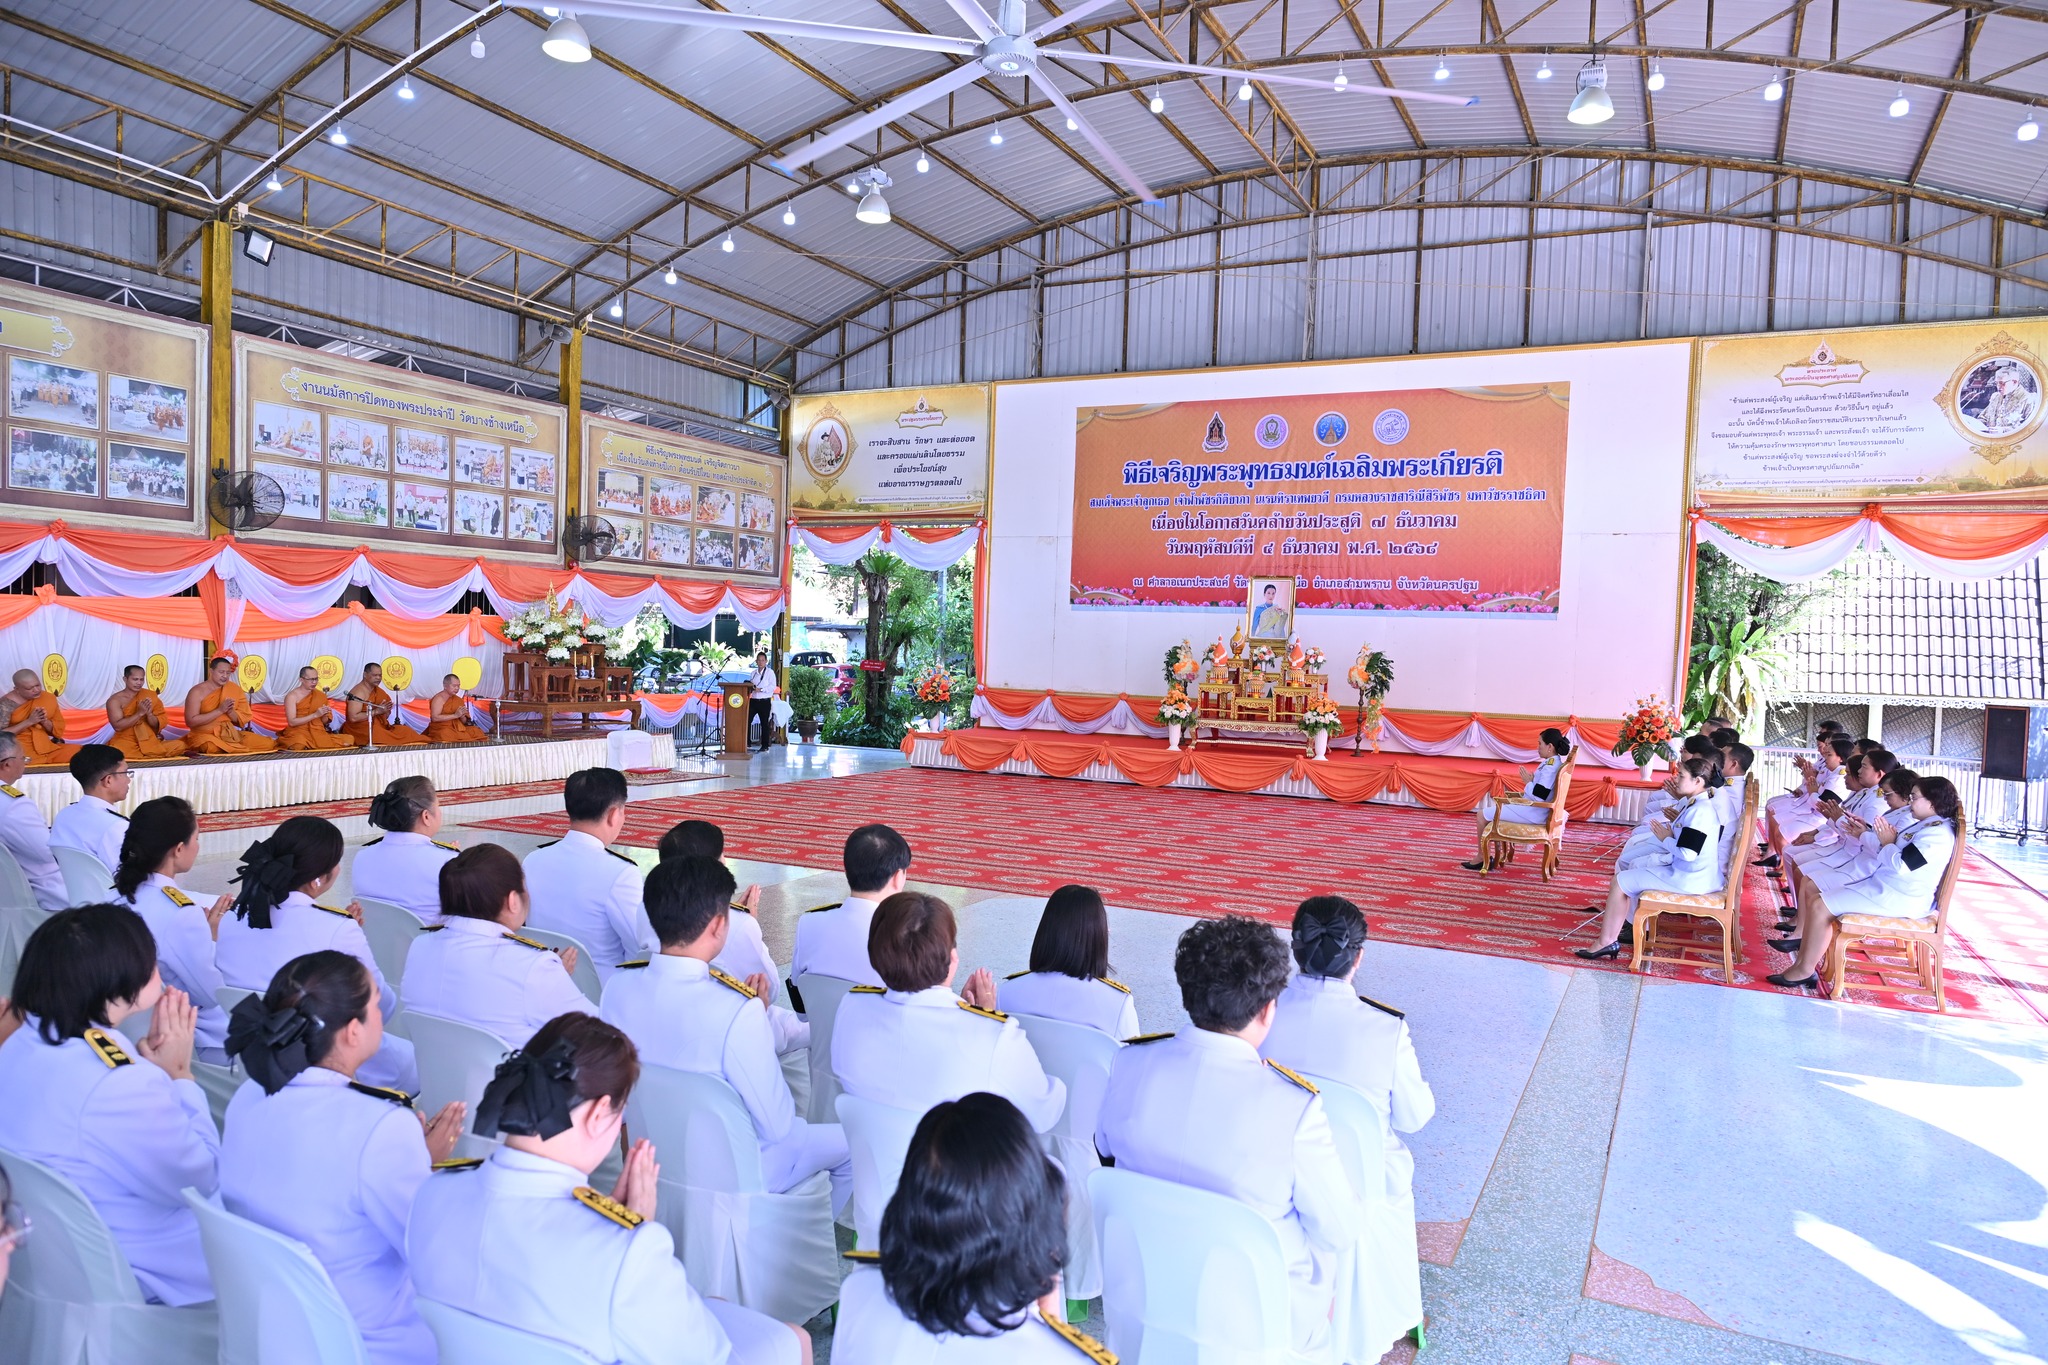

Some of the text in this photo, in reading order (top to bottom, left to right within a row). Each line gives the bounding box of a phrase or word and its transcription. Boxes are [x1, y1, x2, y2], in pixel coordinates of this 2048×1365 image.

[301, 380, 525, 434] งานนมัสการปิดทองพระประจำปี วัดบางช้างเหนือ
[914, 436, 933, 445] รักษา
[876, 448, 966, 461] และครองแผ่นดินโดยธรรม
[893, 463, 947, 474] เพื่อประโยชน์สุข
[1123, 449, 1504, 488] พิธีเจริญพระพุทธมนต์เฉลิมพระเกียรติ
[878, 476, 963, 488] แห่งอาณาราษฎรตลอดไป
[1089, 494, 1170, 510] สมเด็จพระเจ้าลูกเธอ
[1151, 510, 1458, 533] เนื่องในโอกาสวันคล้ายวันประสูติ ๗ ธันวาคม
[1166, 534, 1439, 558] วันพฤหัสบดีที่ ๔ ธันวาคม พ.ศ. ๒๕๖๘
[1132, 577, 1143, 588] ณ
[1147, 575, 1230, 589] ศาลาอเนกประสงค์
[1313, 575, 1392, 590] อำเภอสามพราน
[1396, 576, 1479, 594] จังหวัดนครปฐม
